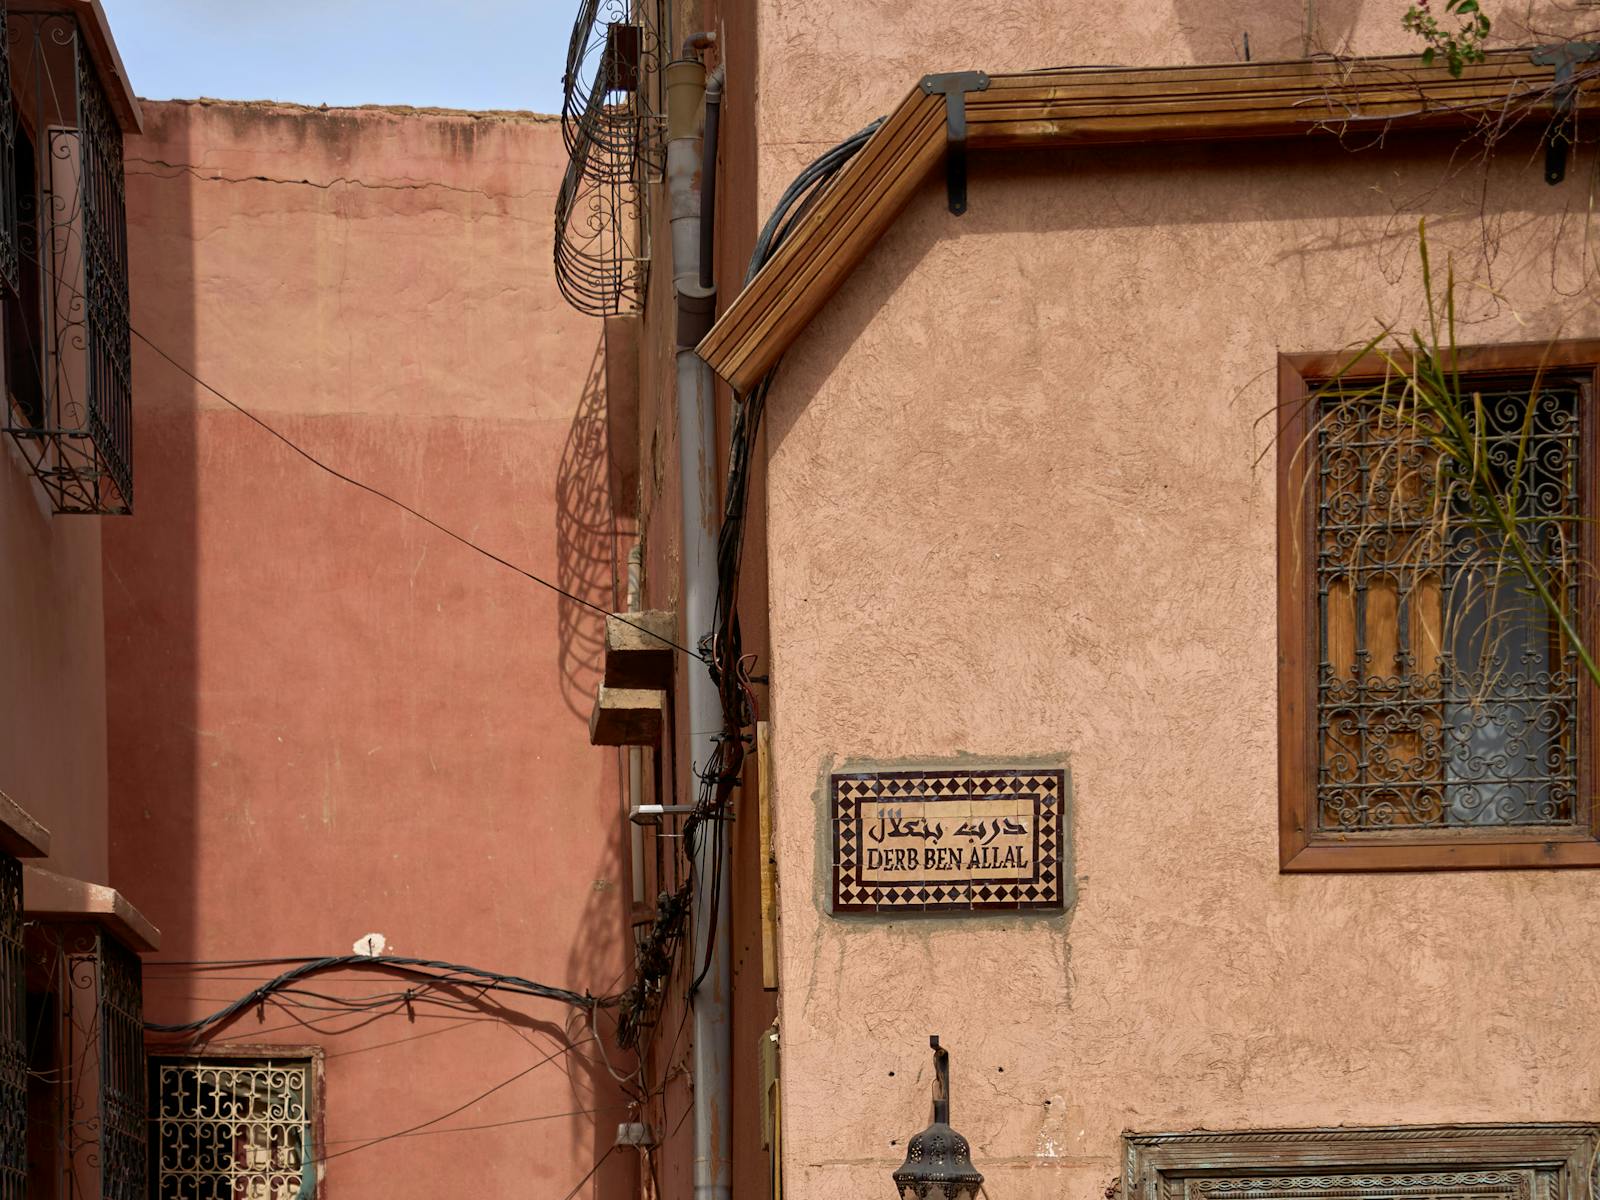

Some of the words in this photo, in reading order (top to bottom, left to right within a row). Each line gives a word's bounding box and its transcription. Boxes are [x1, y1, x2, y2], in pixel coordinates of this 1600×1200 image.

[953, 817, 1028, 845] درب
[866, 848, 920, 871] DERB
[924, 848, 963, 871] BEN
[966, 846, 1028, 870] ALLAL
